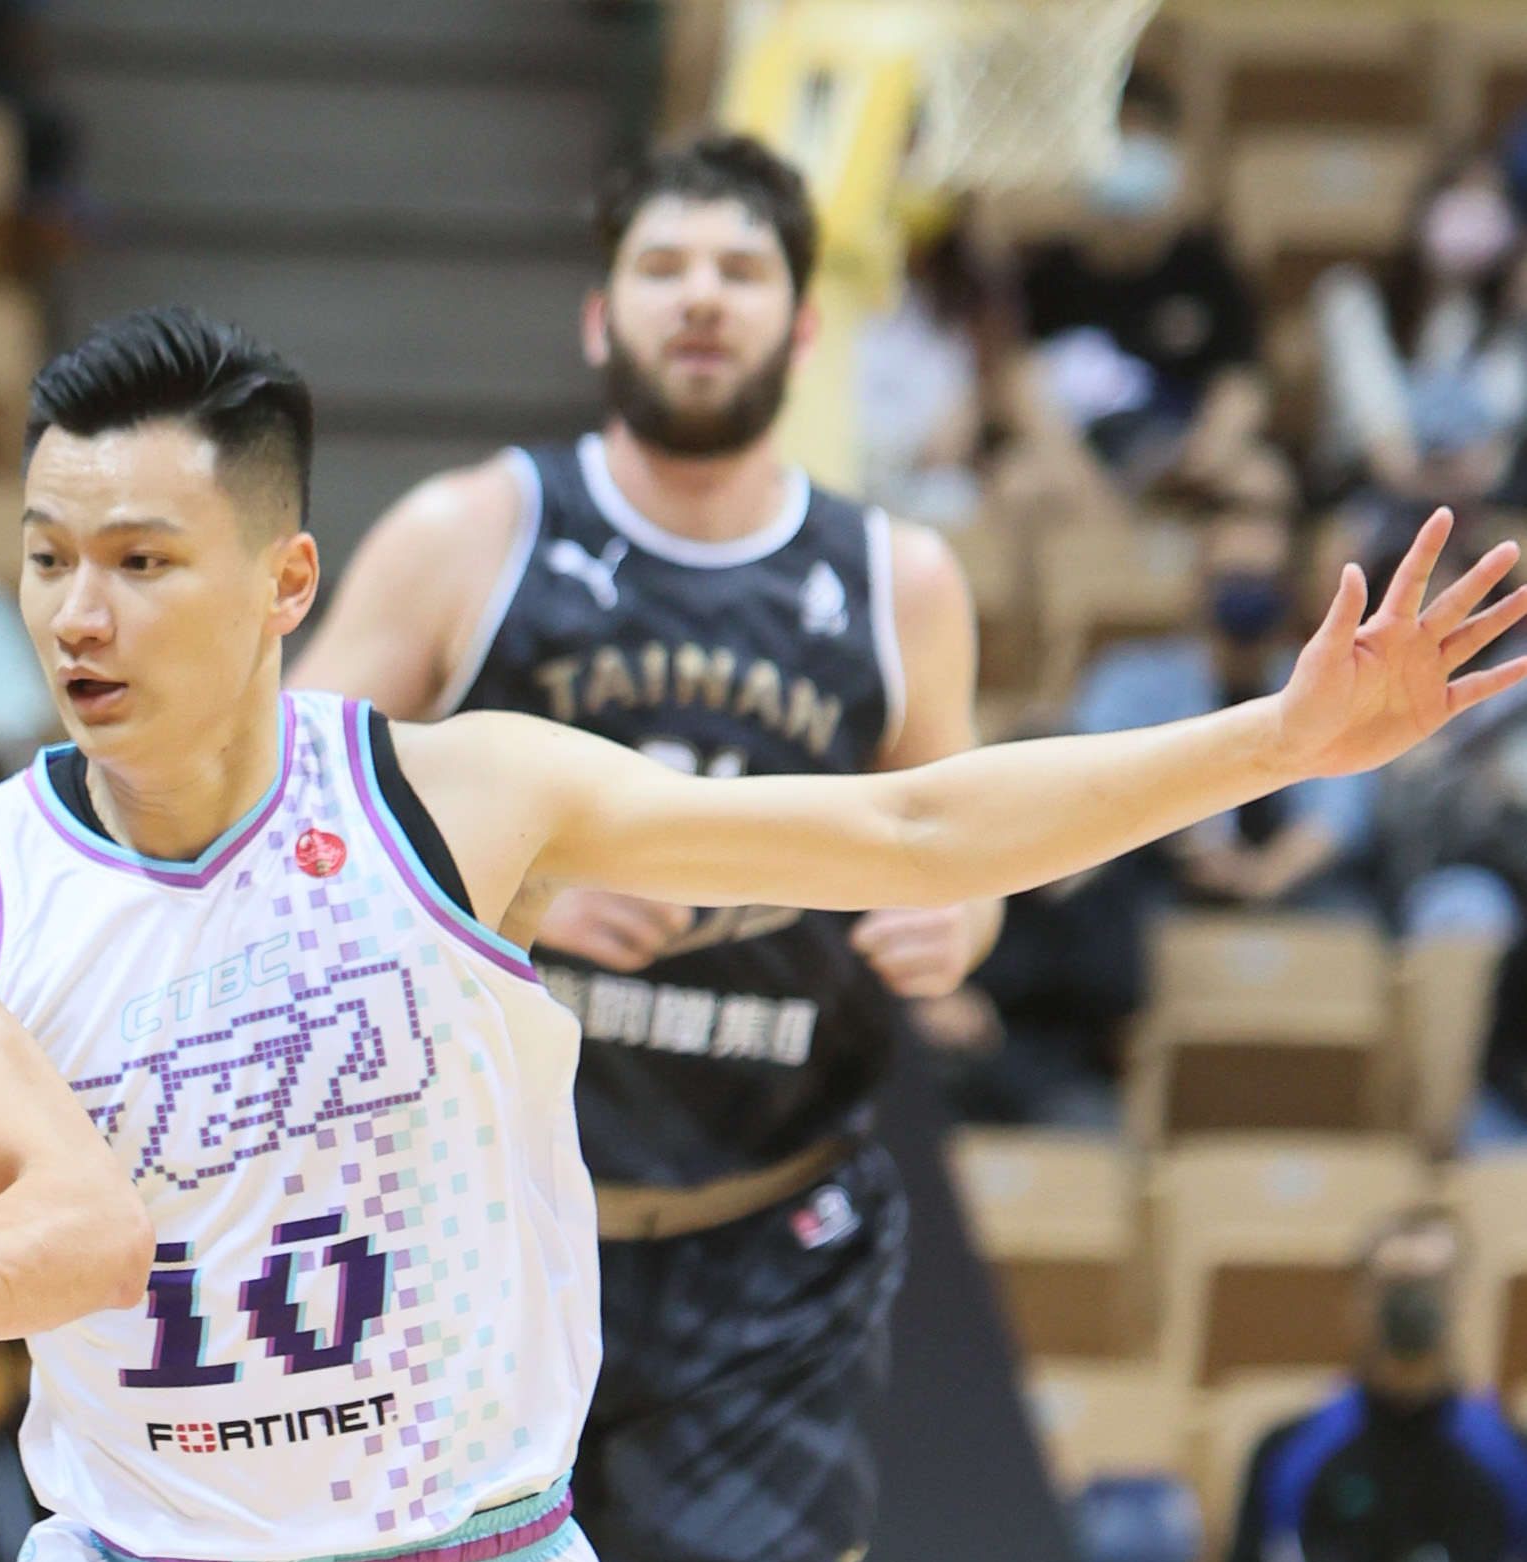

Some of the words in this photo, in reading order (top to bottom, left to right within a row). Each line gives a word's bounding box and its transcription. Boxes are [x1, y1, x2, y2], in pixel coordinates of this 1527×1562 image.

[533, 640, 842, 758] TAINAN
[121, 931, 290, 1043] CTBC
[118, 1212, 396, 1389] 10
[146, 1391, 395, 1453] FORTINET
